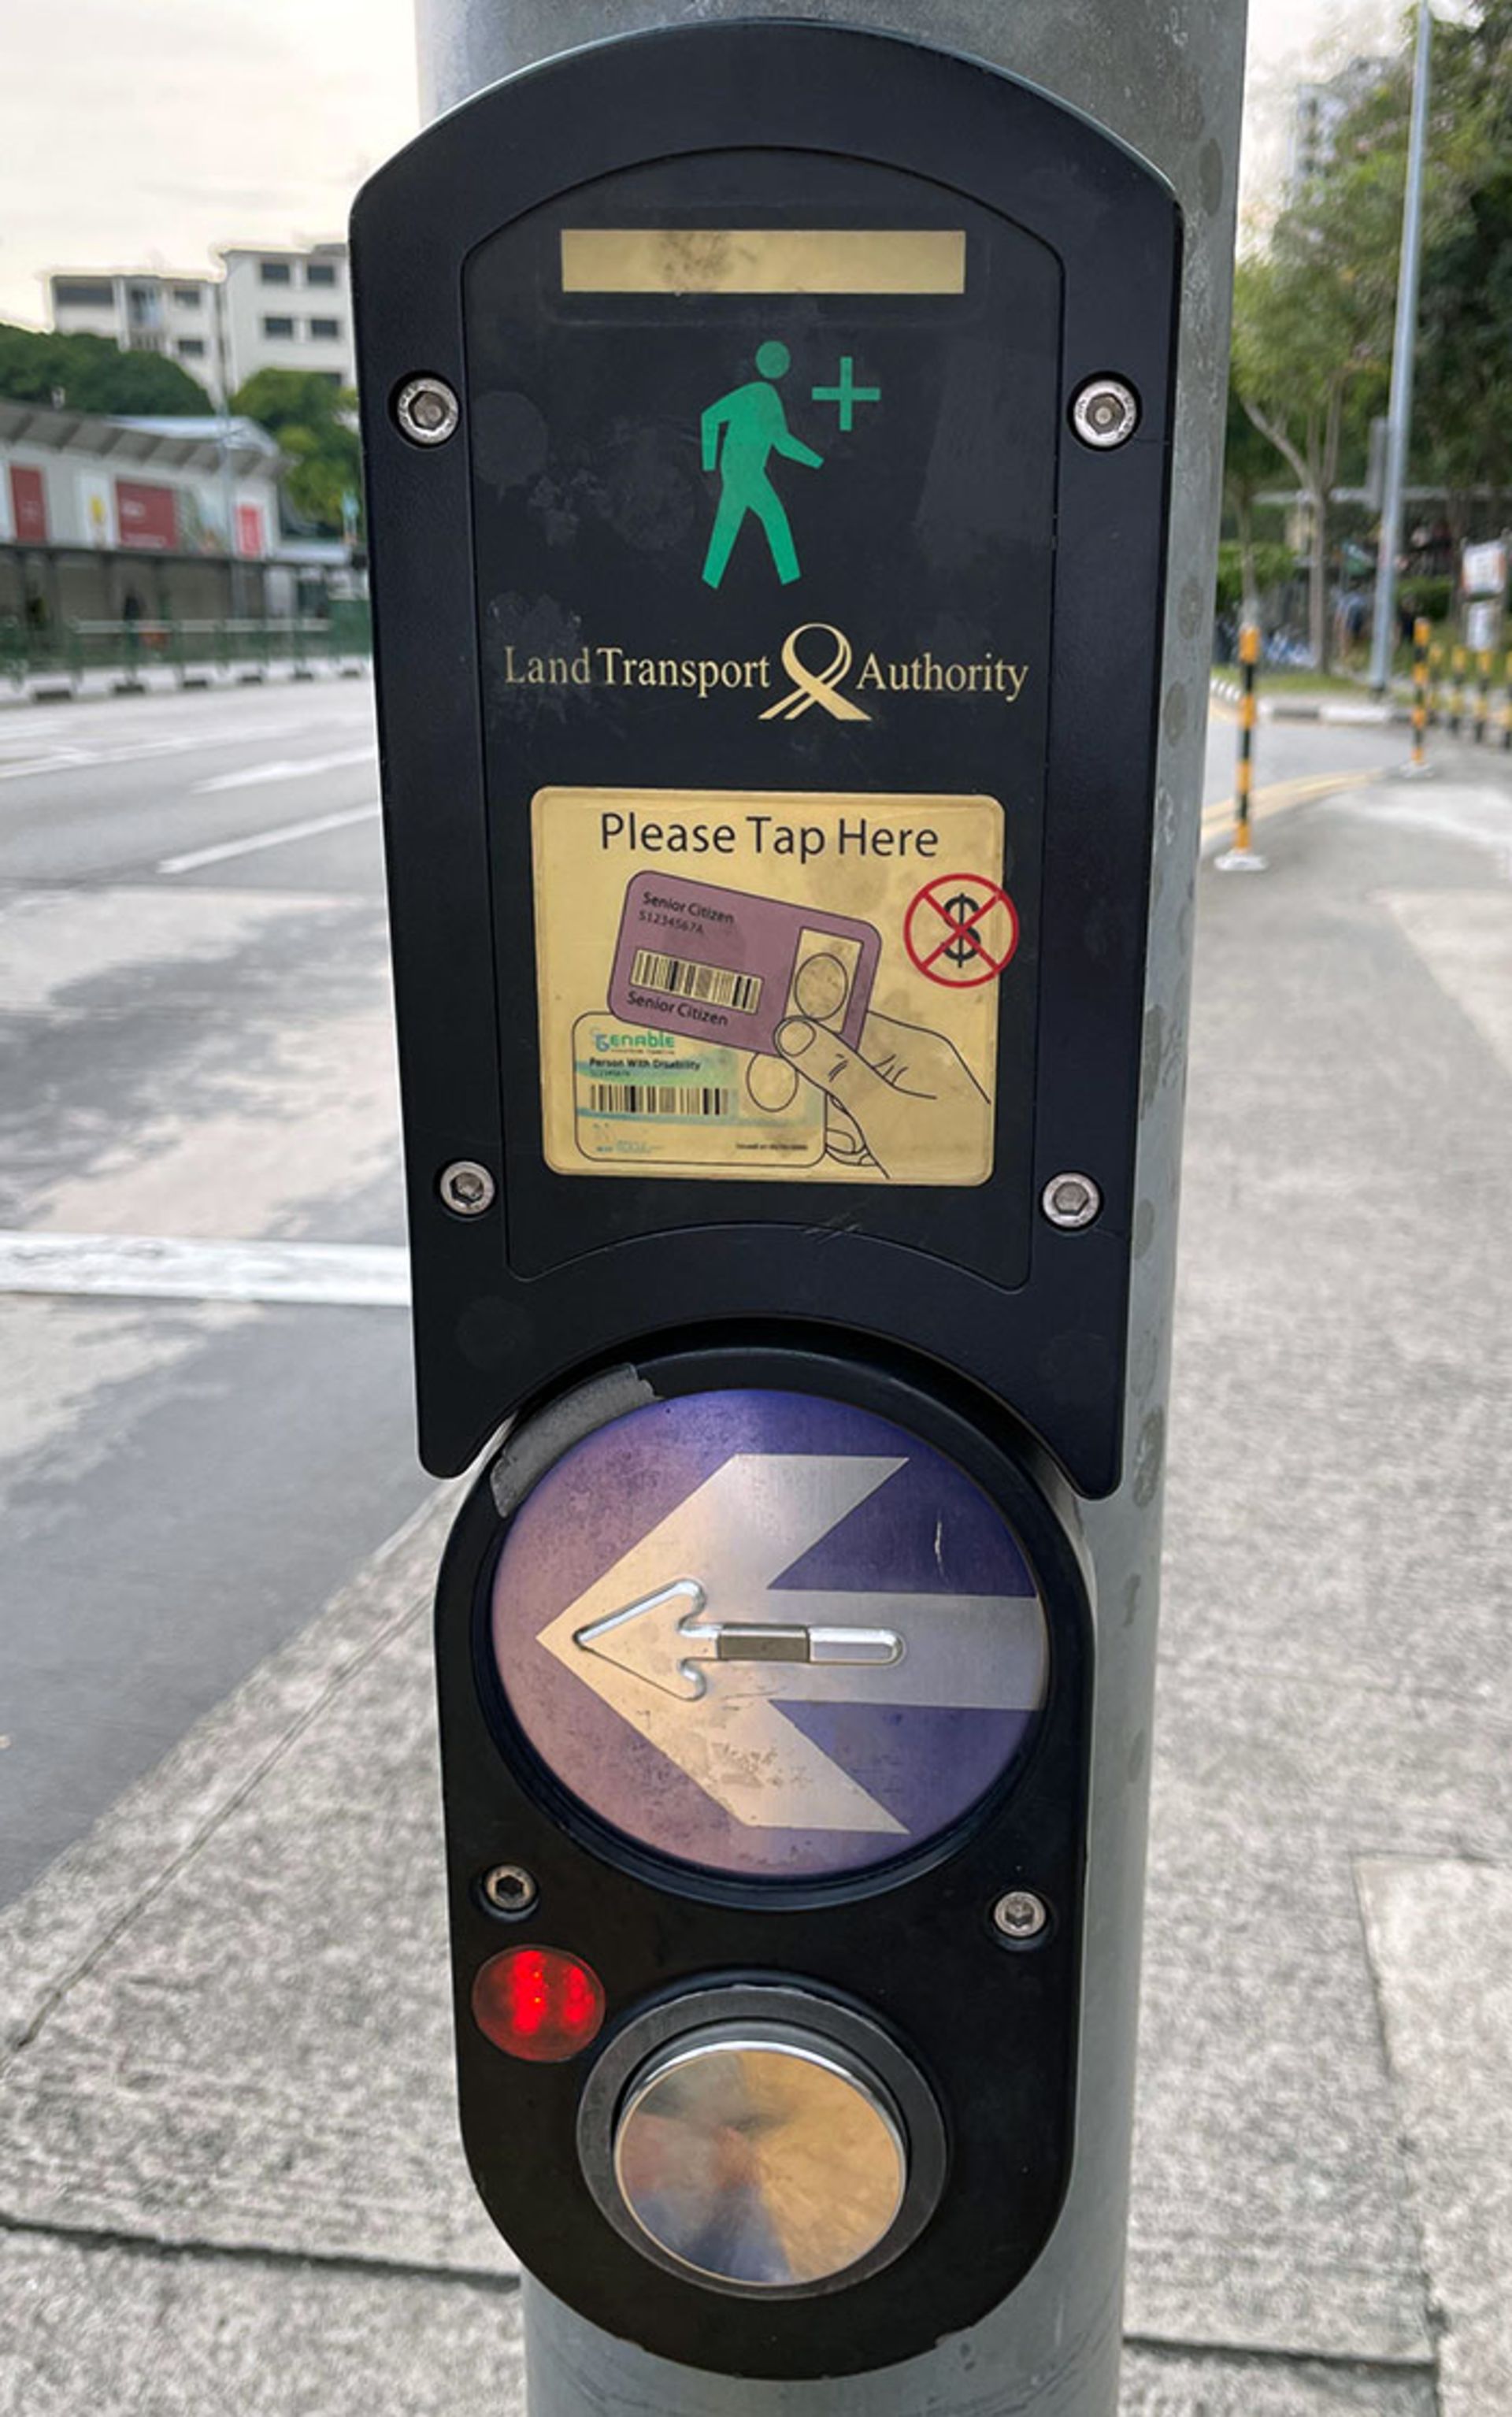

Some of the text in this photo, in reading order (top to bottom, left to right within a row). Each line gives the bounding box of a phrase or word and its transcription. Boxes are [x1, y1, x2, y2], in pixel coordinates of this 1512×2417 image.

[504, 645, 1029, 702] Land Transport Authority
[602, 811, 939, 865] Please Tap Here
[643, 891, 735, 925] Senior Citizen
[627, 990, 728, 1027] Senior Citizen
[589, 1057, 624, 1068] Person
[652, 1058, 700, 1072] Disability
